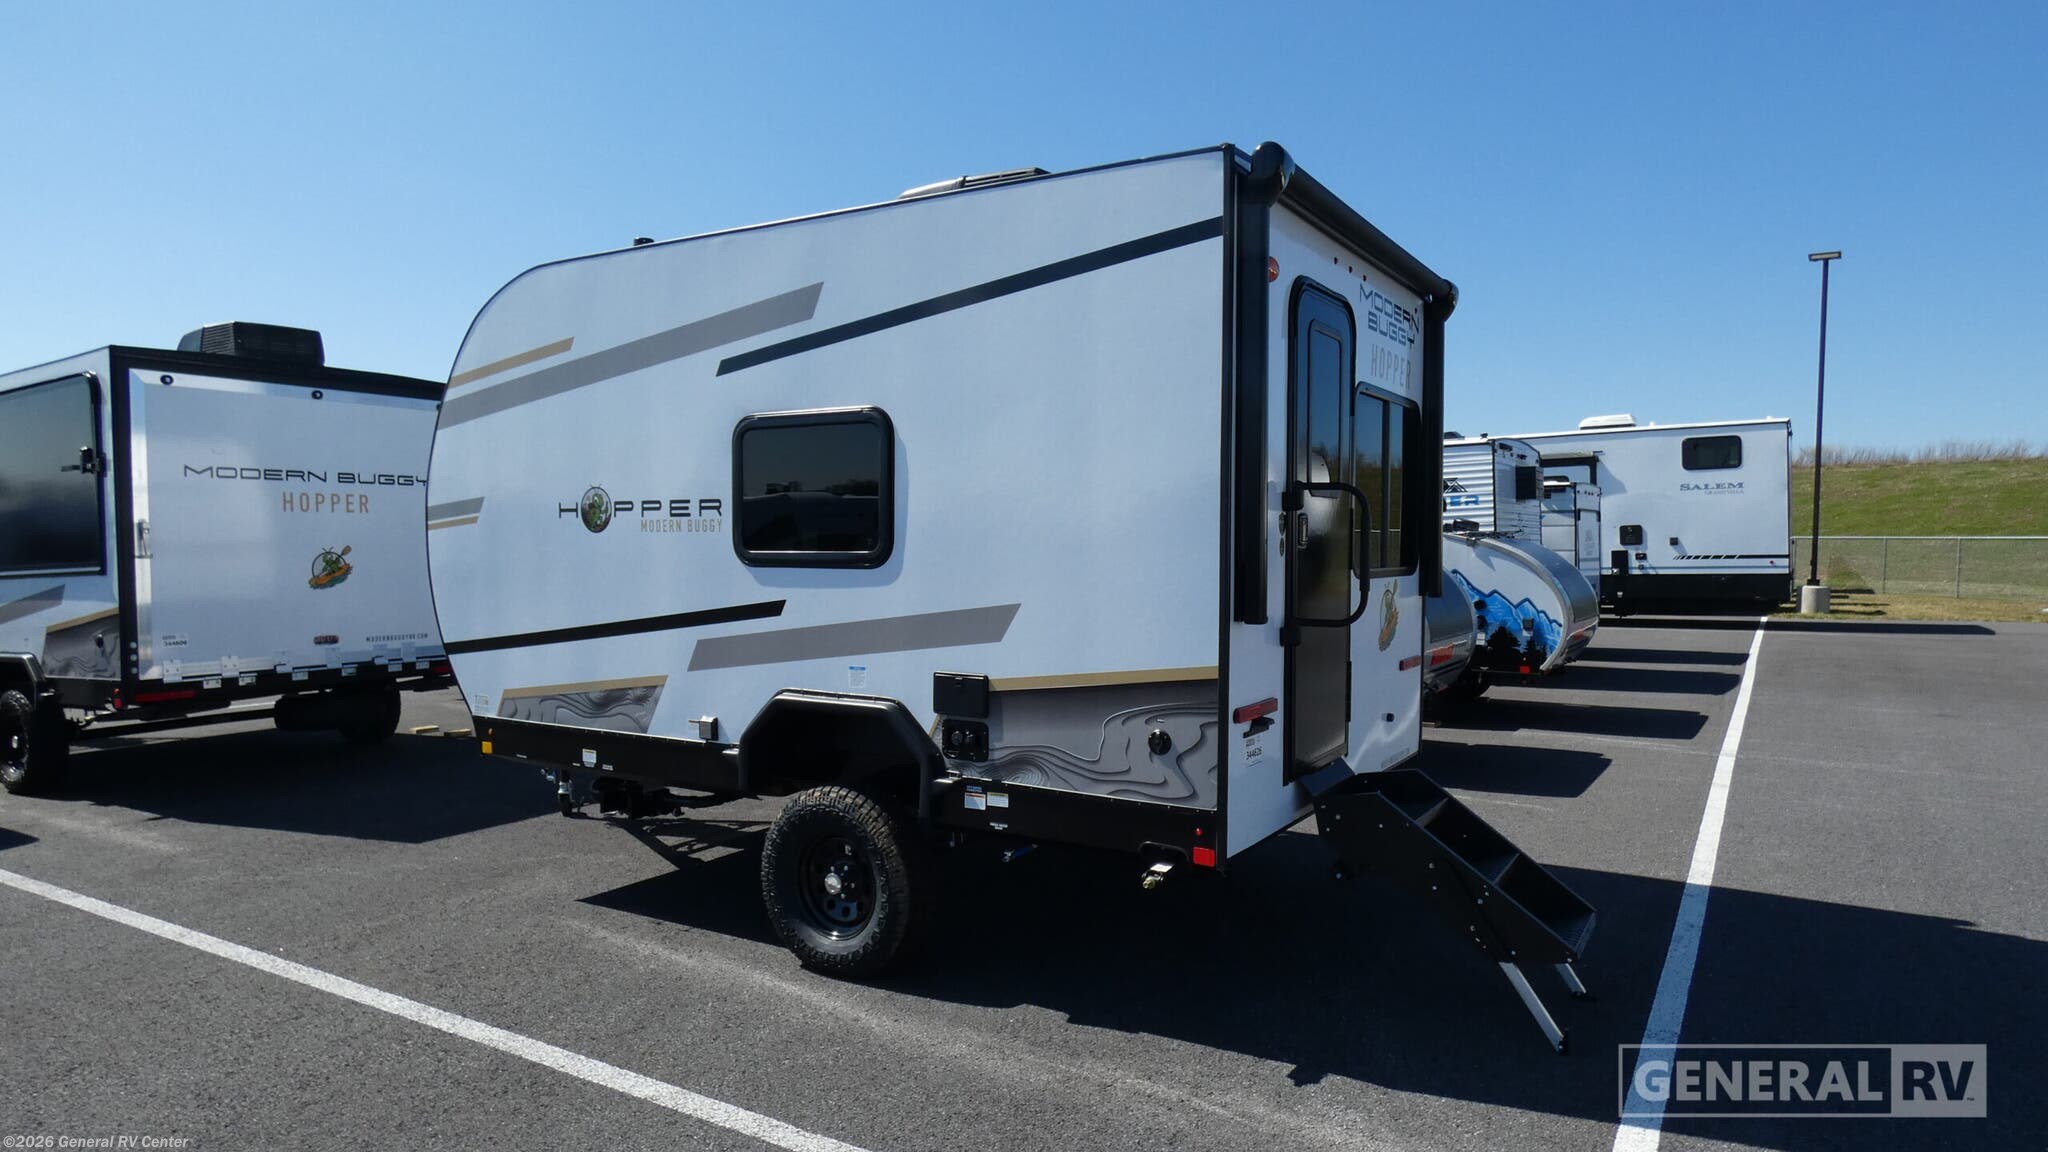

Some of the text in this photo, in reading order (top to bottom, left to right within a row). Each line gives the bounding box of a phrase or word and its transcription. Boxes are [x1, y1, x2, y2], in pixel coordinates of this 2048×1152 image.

[1360, 284, 1419, 333] MODERN
[1368, 311, 1415, 350] BUGGY
[1371, 344, 1411, 390] HOPPER
[184, 465, 427, 486] MODERN BUGGY
[1680, 482, 1744, 491] SALEM
[282, 491, 369, 513] HOPPER
[558, 487, 722, 533] HOPPER
[640, 518, 723, 533] MODERN BUGGY
